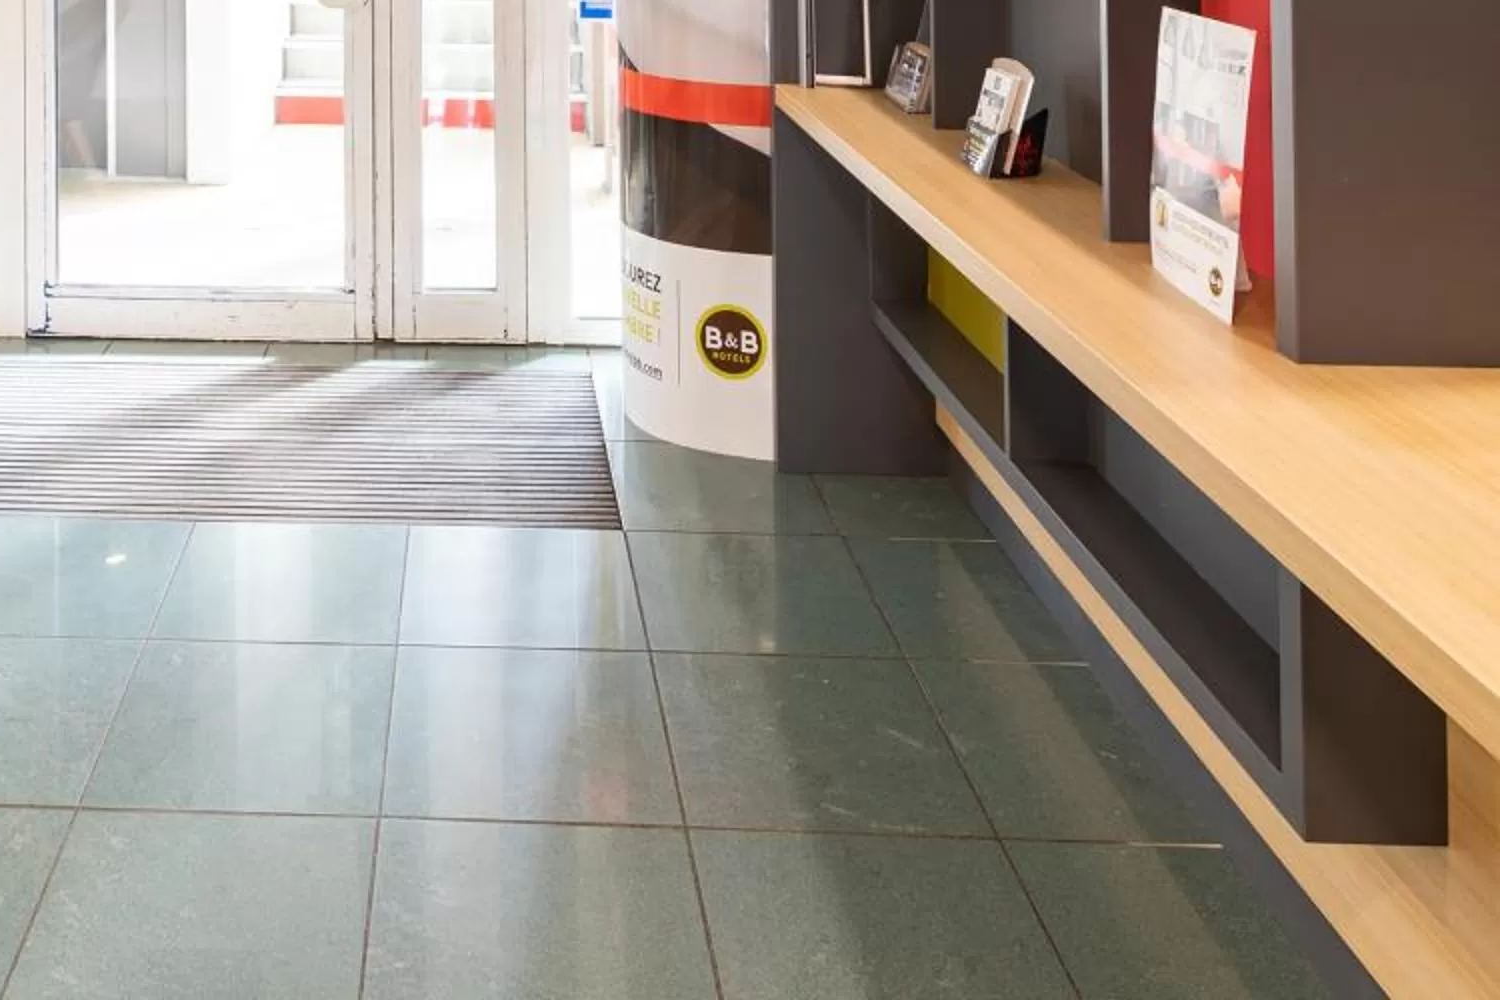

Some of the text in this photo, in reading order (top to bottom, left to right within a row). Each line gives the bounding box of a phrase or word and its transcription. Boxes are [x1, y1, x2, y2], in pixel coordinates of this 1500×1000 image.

[621, 256, 662, 294] UREZ
[704, 324, 760, 355] B&B
[711, 351, 751, 364] HOTELS
